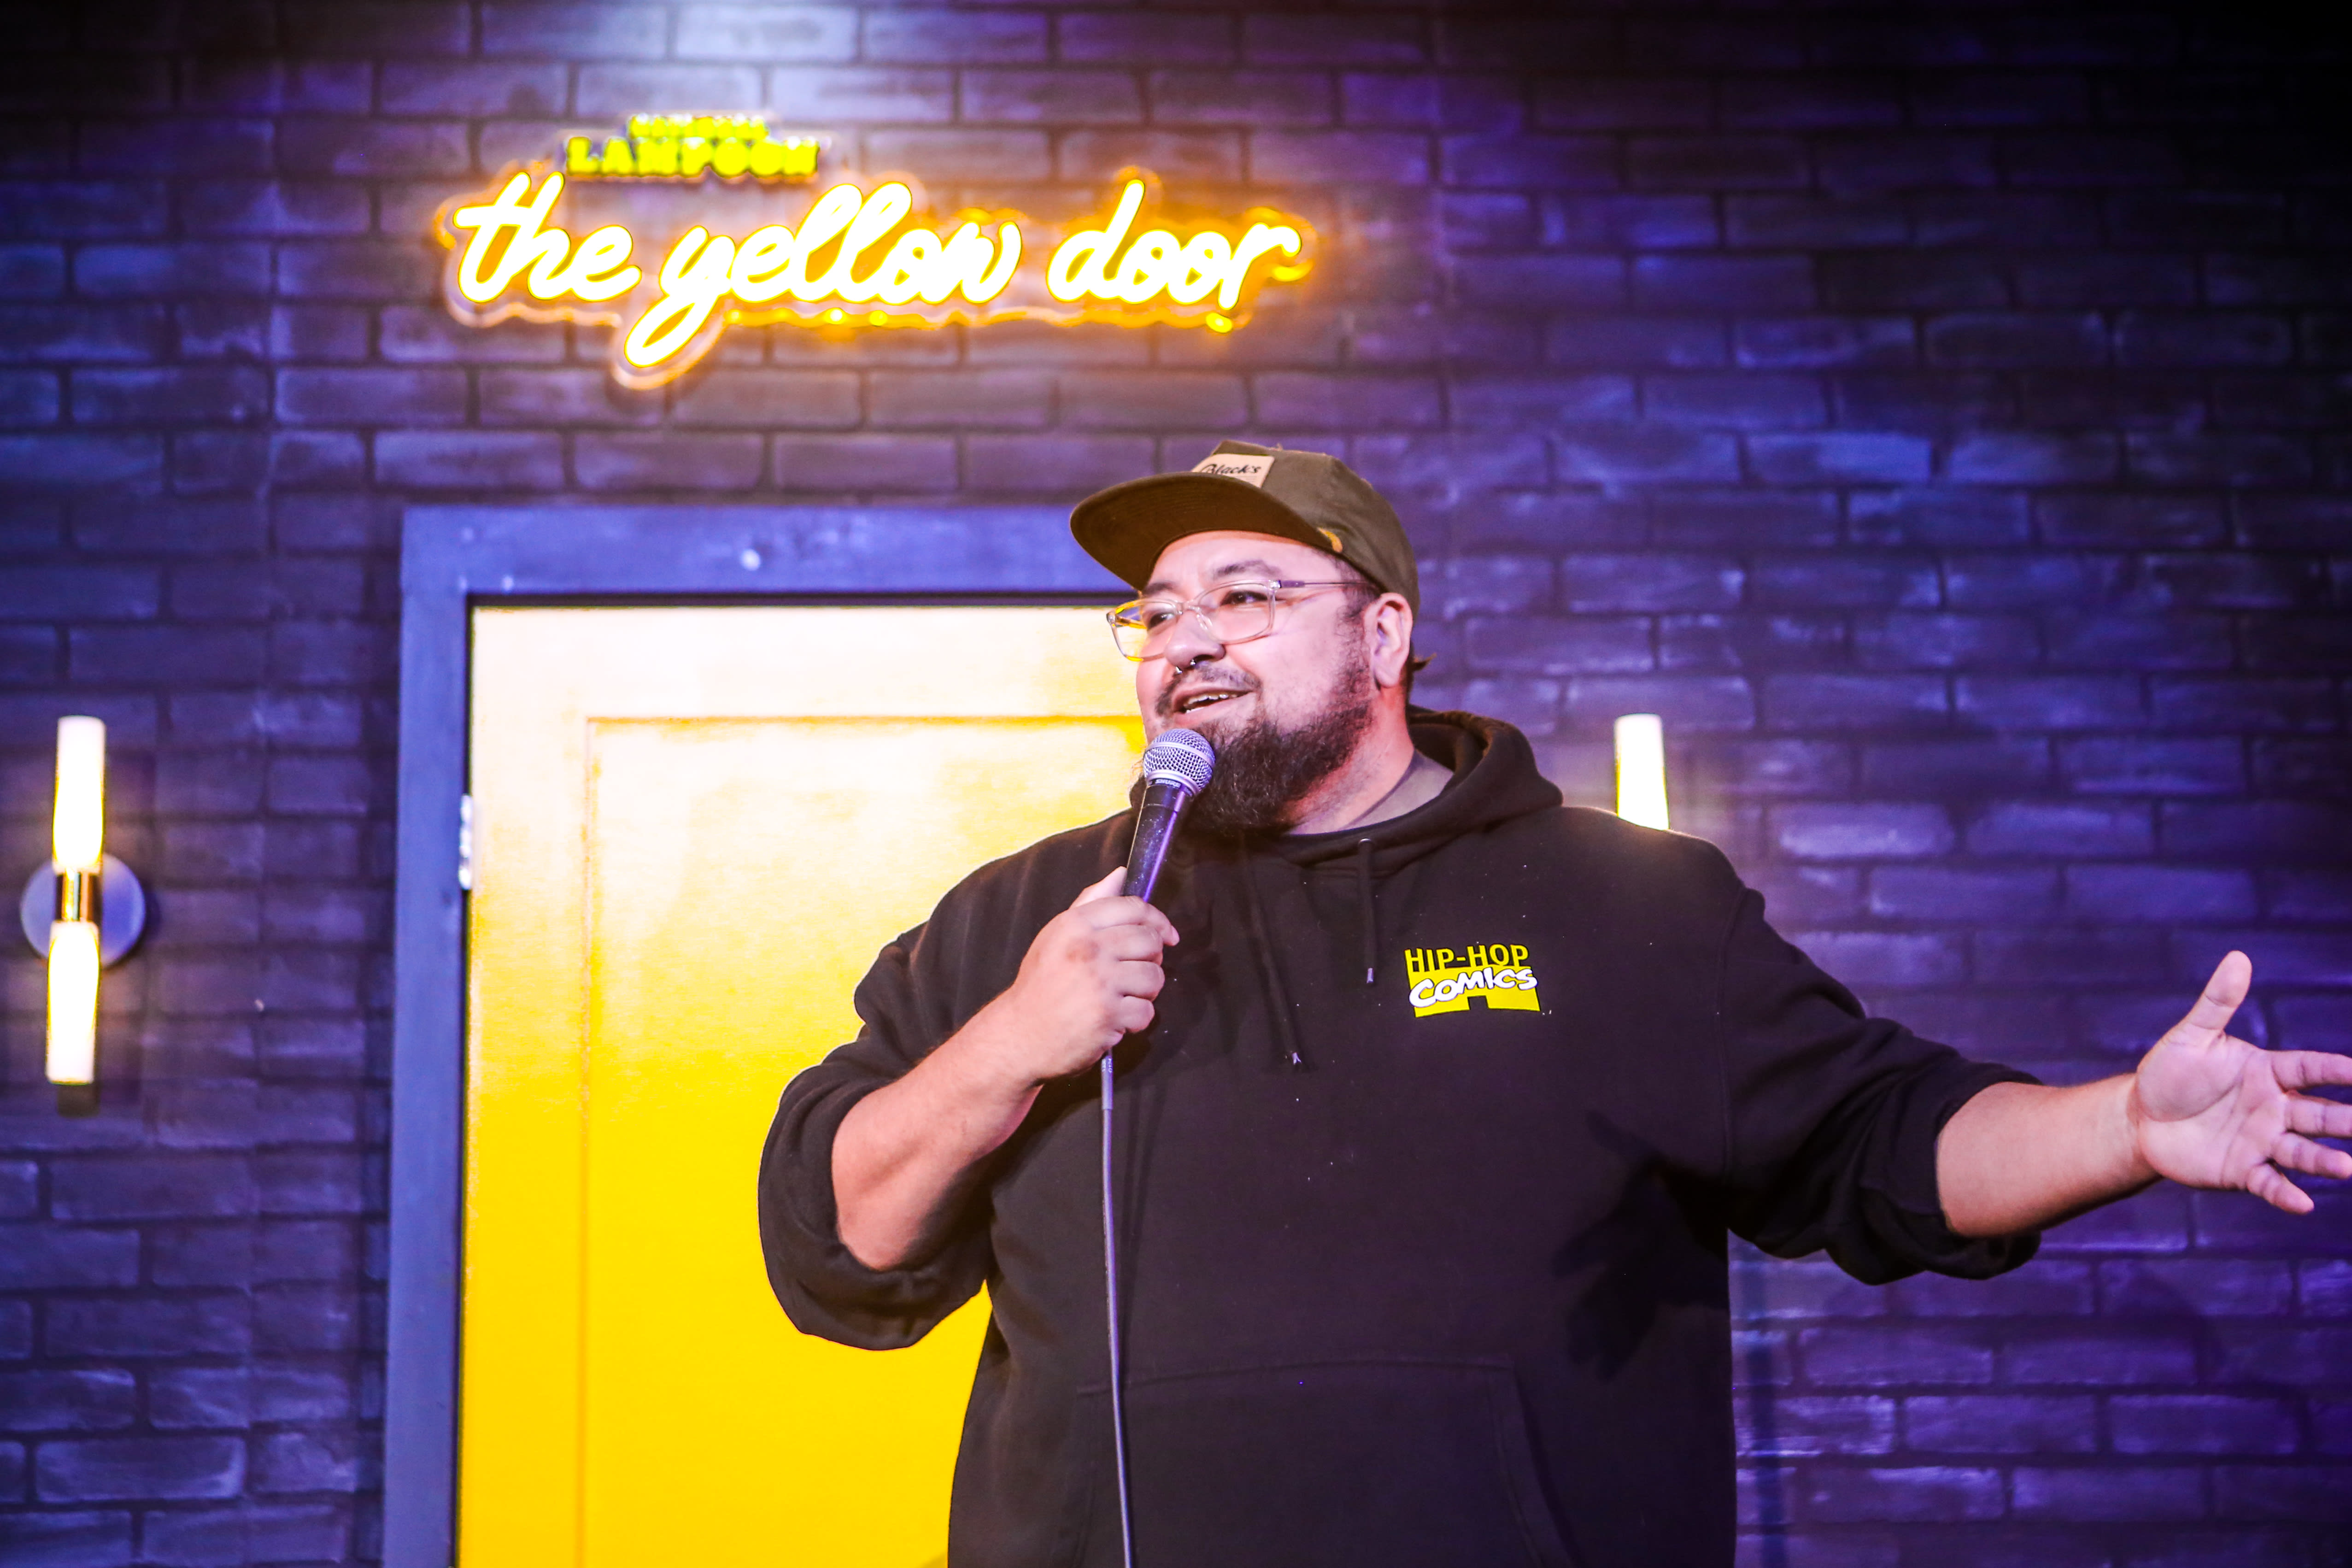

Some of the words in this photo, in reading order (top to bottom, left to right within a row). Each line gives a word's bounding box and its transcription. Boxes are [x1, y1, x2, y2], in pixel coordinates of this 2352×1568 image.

[567, 136, 819, 176] LAMPOON
[452, 171, 642, 302] the
[624, 181, 1022, 367] yellow
[1046, 179, 1302, 310] door
[1200, 463, 1261, 476] Black's
[1155, 779, 1181, 788] SHURE
[1404, 944, 1529, 972] HIP-HOP
[1408, 966, 1538, 1008] COMICS
